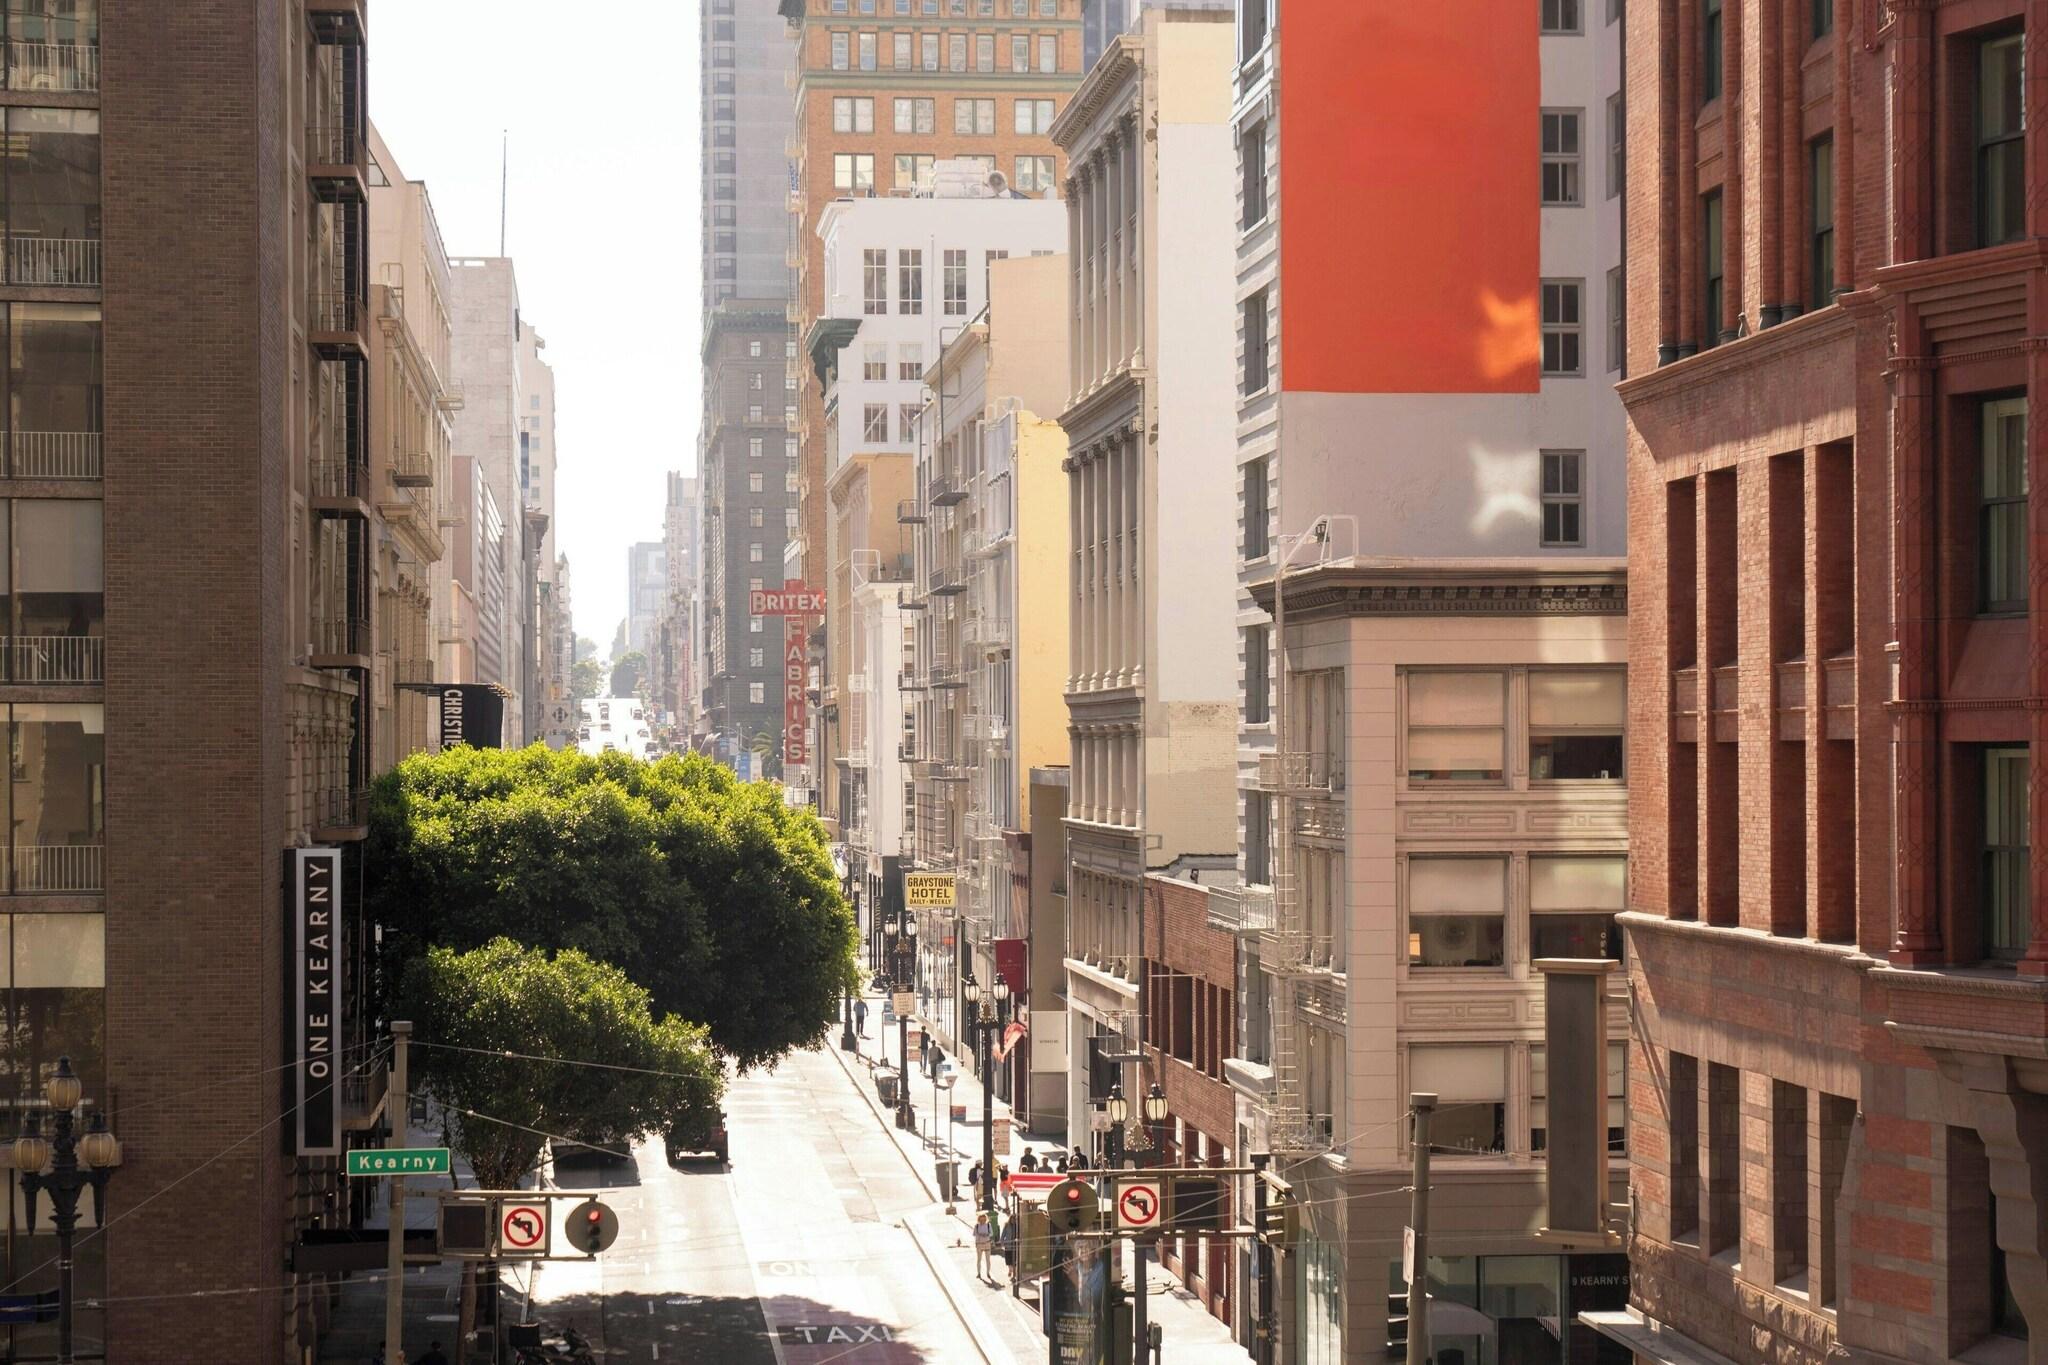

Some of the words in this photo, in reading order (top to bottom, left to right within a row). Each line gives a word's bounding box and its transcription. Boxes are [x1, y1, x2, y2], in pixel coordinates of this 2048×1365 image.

[752, 591, 822, 613] BRITEX
[786, 621, 804, 760] FABRICS
[907, 877, 954, 888] GRAYSTONE
[911, 888, 950, 898] HOTEL
[309, 862, 328, 994] KEARNY
[309, 1013, 328, 1078] ONE
[360, 1153, 438, 1171] Kearny
[1580, 1276, 1619, 1286] KEARNY
[794, 1325, 894, 1344] TAXI
